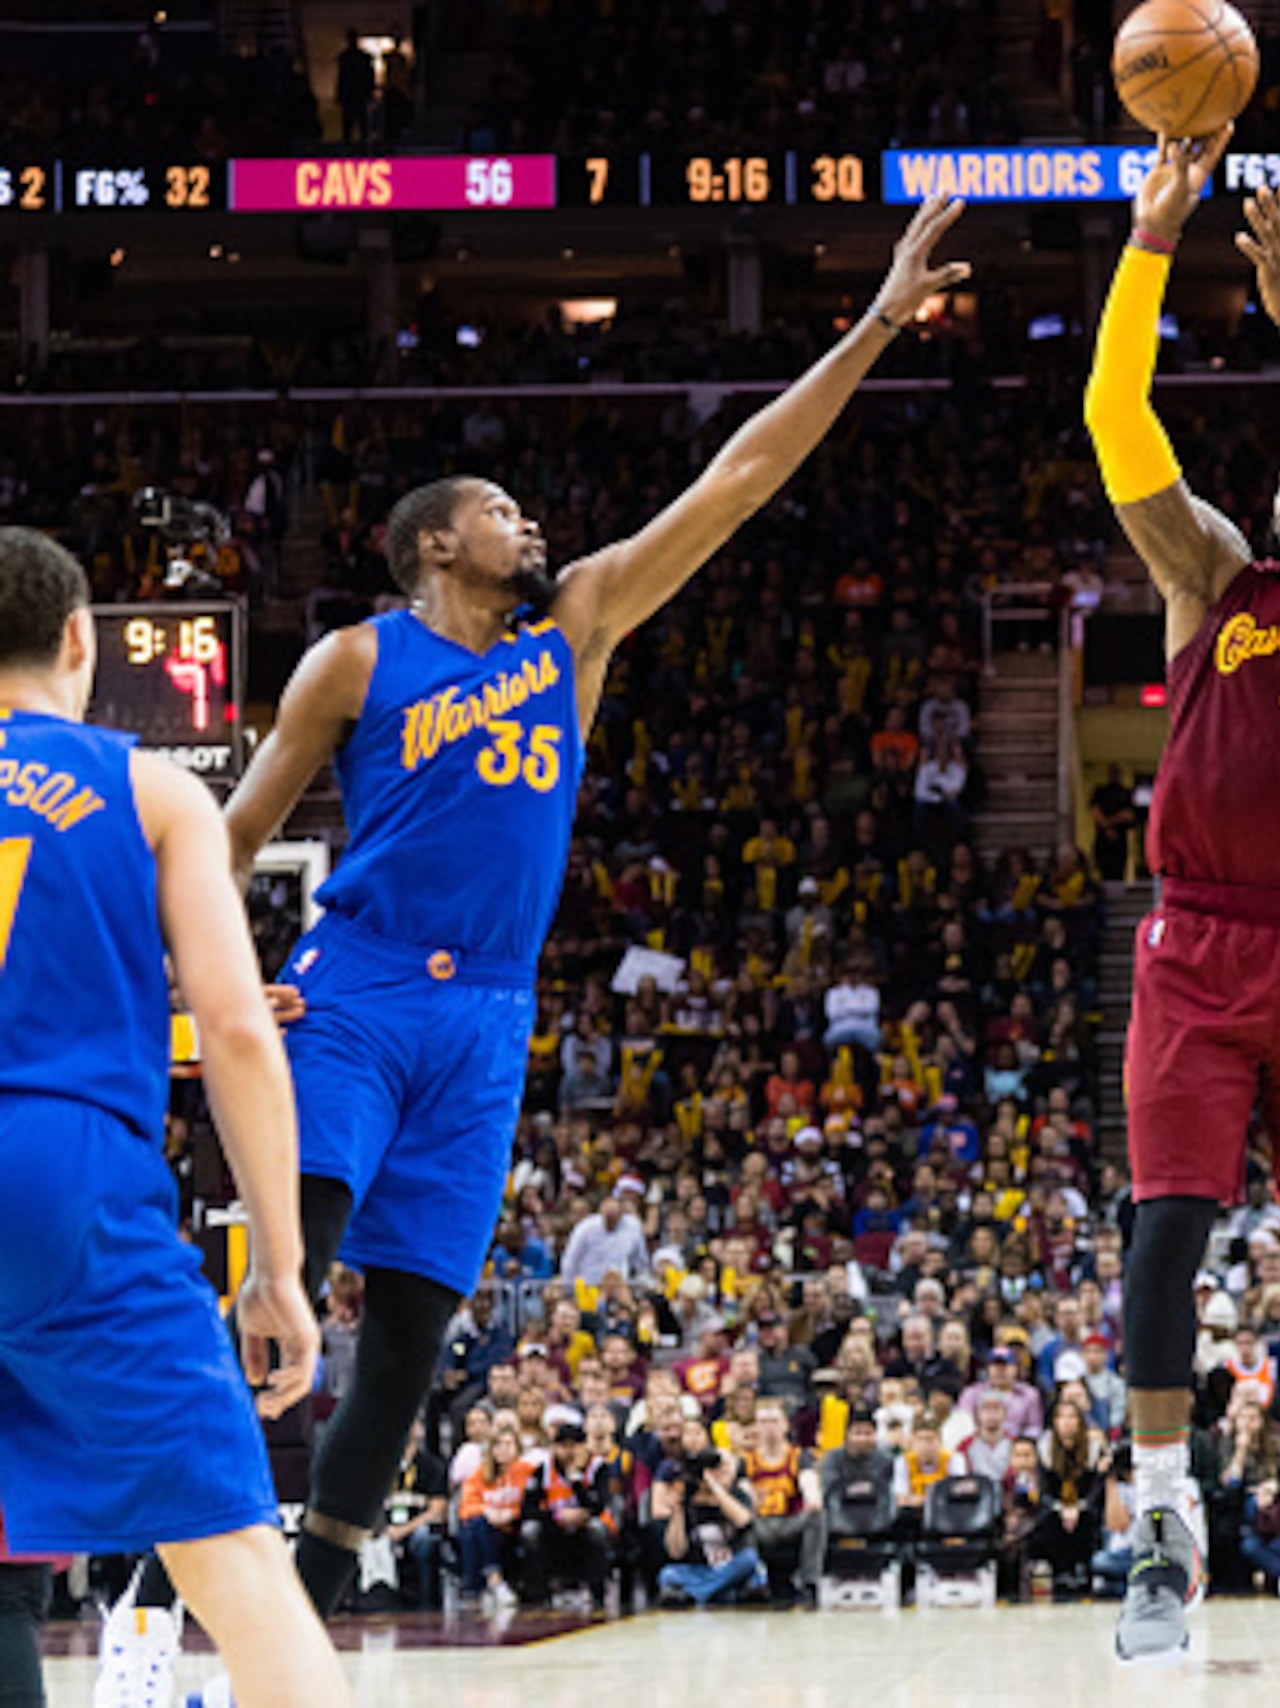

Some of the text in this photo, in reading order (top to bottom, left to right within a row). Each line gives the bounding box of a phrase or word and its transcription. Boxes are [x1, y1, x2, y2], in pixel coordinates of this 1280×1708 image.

[20, 167, 45, 209] 2
[75, 166, 210, 208] FG% 32
[296, 159, 513, 205] CAVS 56
[586, 158, 608, 202] 7
[687, 158, 768, 200] 9:16
[812, 156, 863, 200] 3Q
[899, 150, 1103, 197] WARRIORS
[125, 617, 218, 664] 9:16
[402, 651, 559, 771] Warriors
[477, 720, 560, 793] 35
